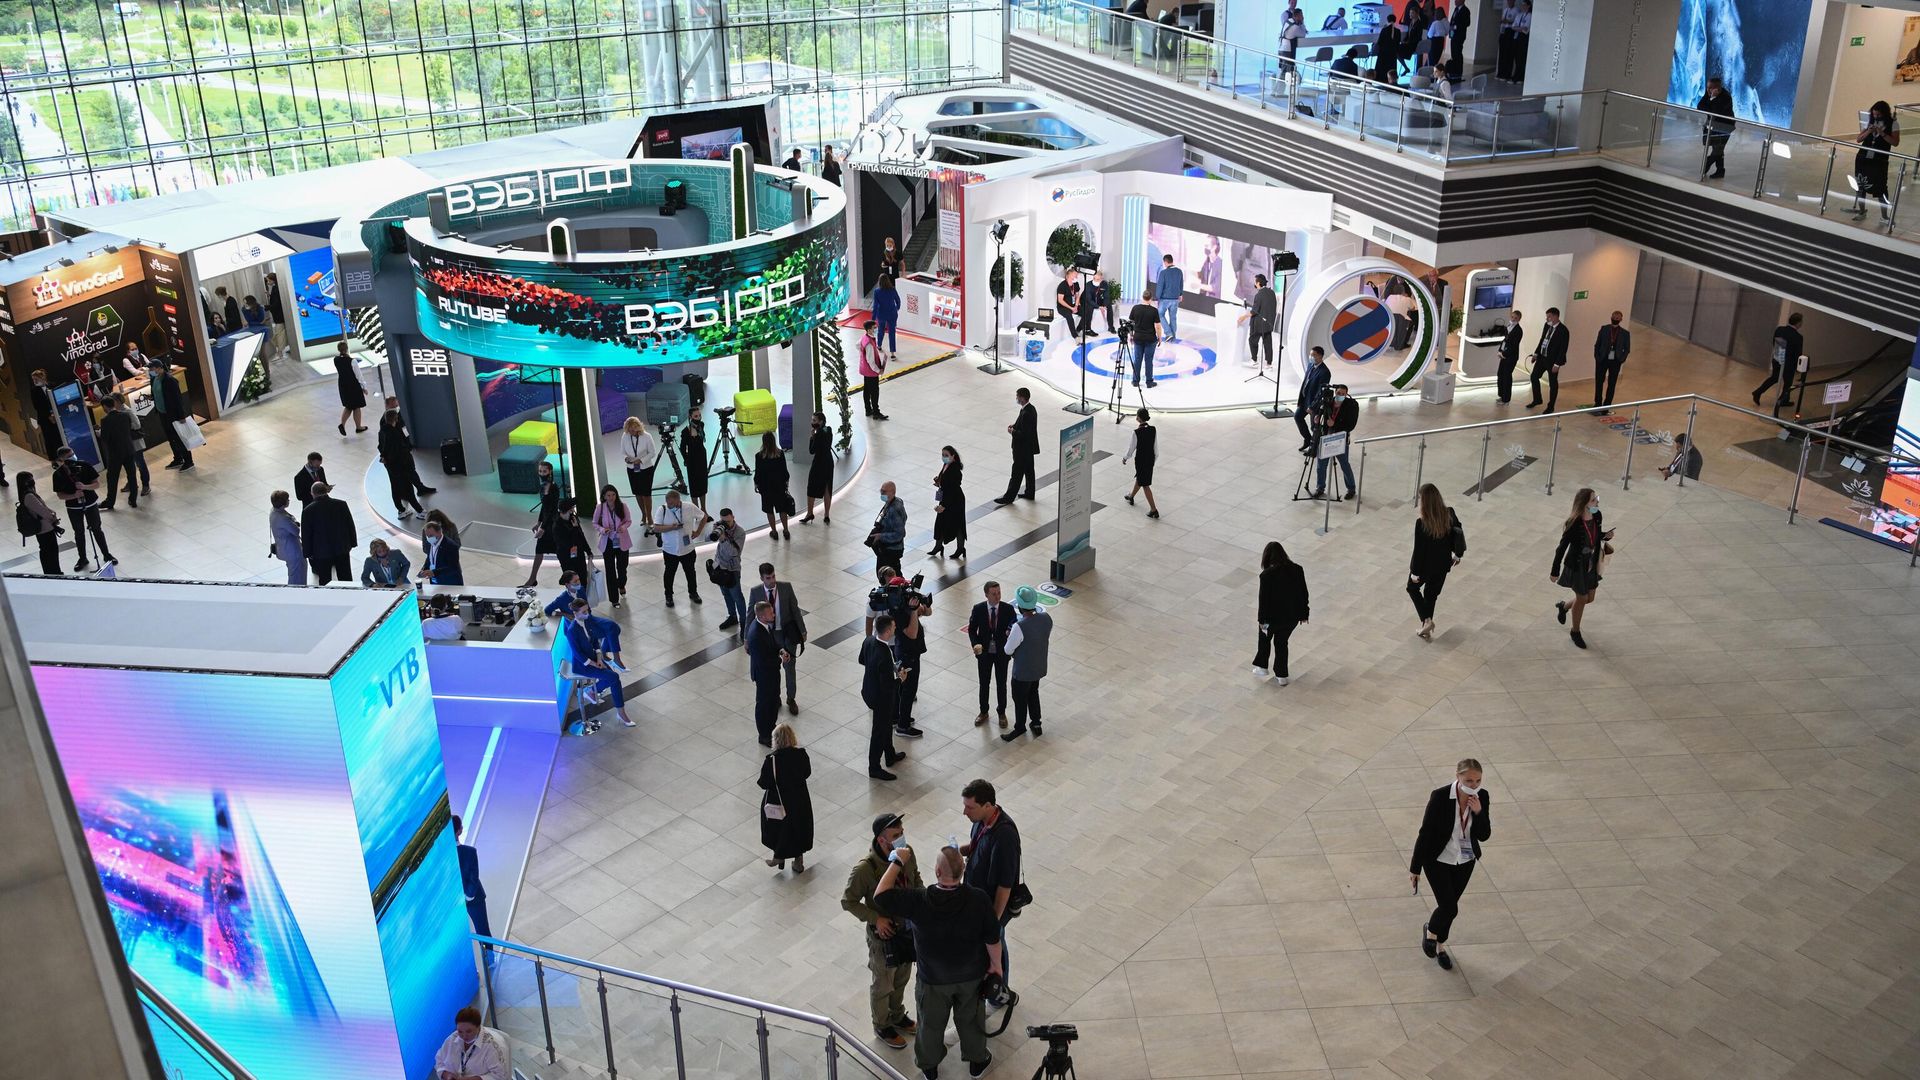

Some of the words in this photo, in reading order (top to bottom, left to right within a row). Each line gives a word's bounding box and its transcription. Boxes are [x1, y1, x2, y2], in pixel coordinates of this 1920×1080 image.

[848, 162, 880, 173] ГРУППА
[880, 165, 930, 178] КОМПАНИЙ
[62, 265, 124, 297] VinoGrad
[345, 270, 371, 282] ВЭБ
[347, 282, 373, 293] РФ
[437, 296, 509, 324] RUTUBE
[61, 336, 108, 362] VinoGrad
[410, 349, 447, 362] ВЭБ
[412, 364, 449, 377] РФ
[379, 647, 420, 709] VTB
